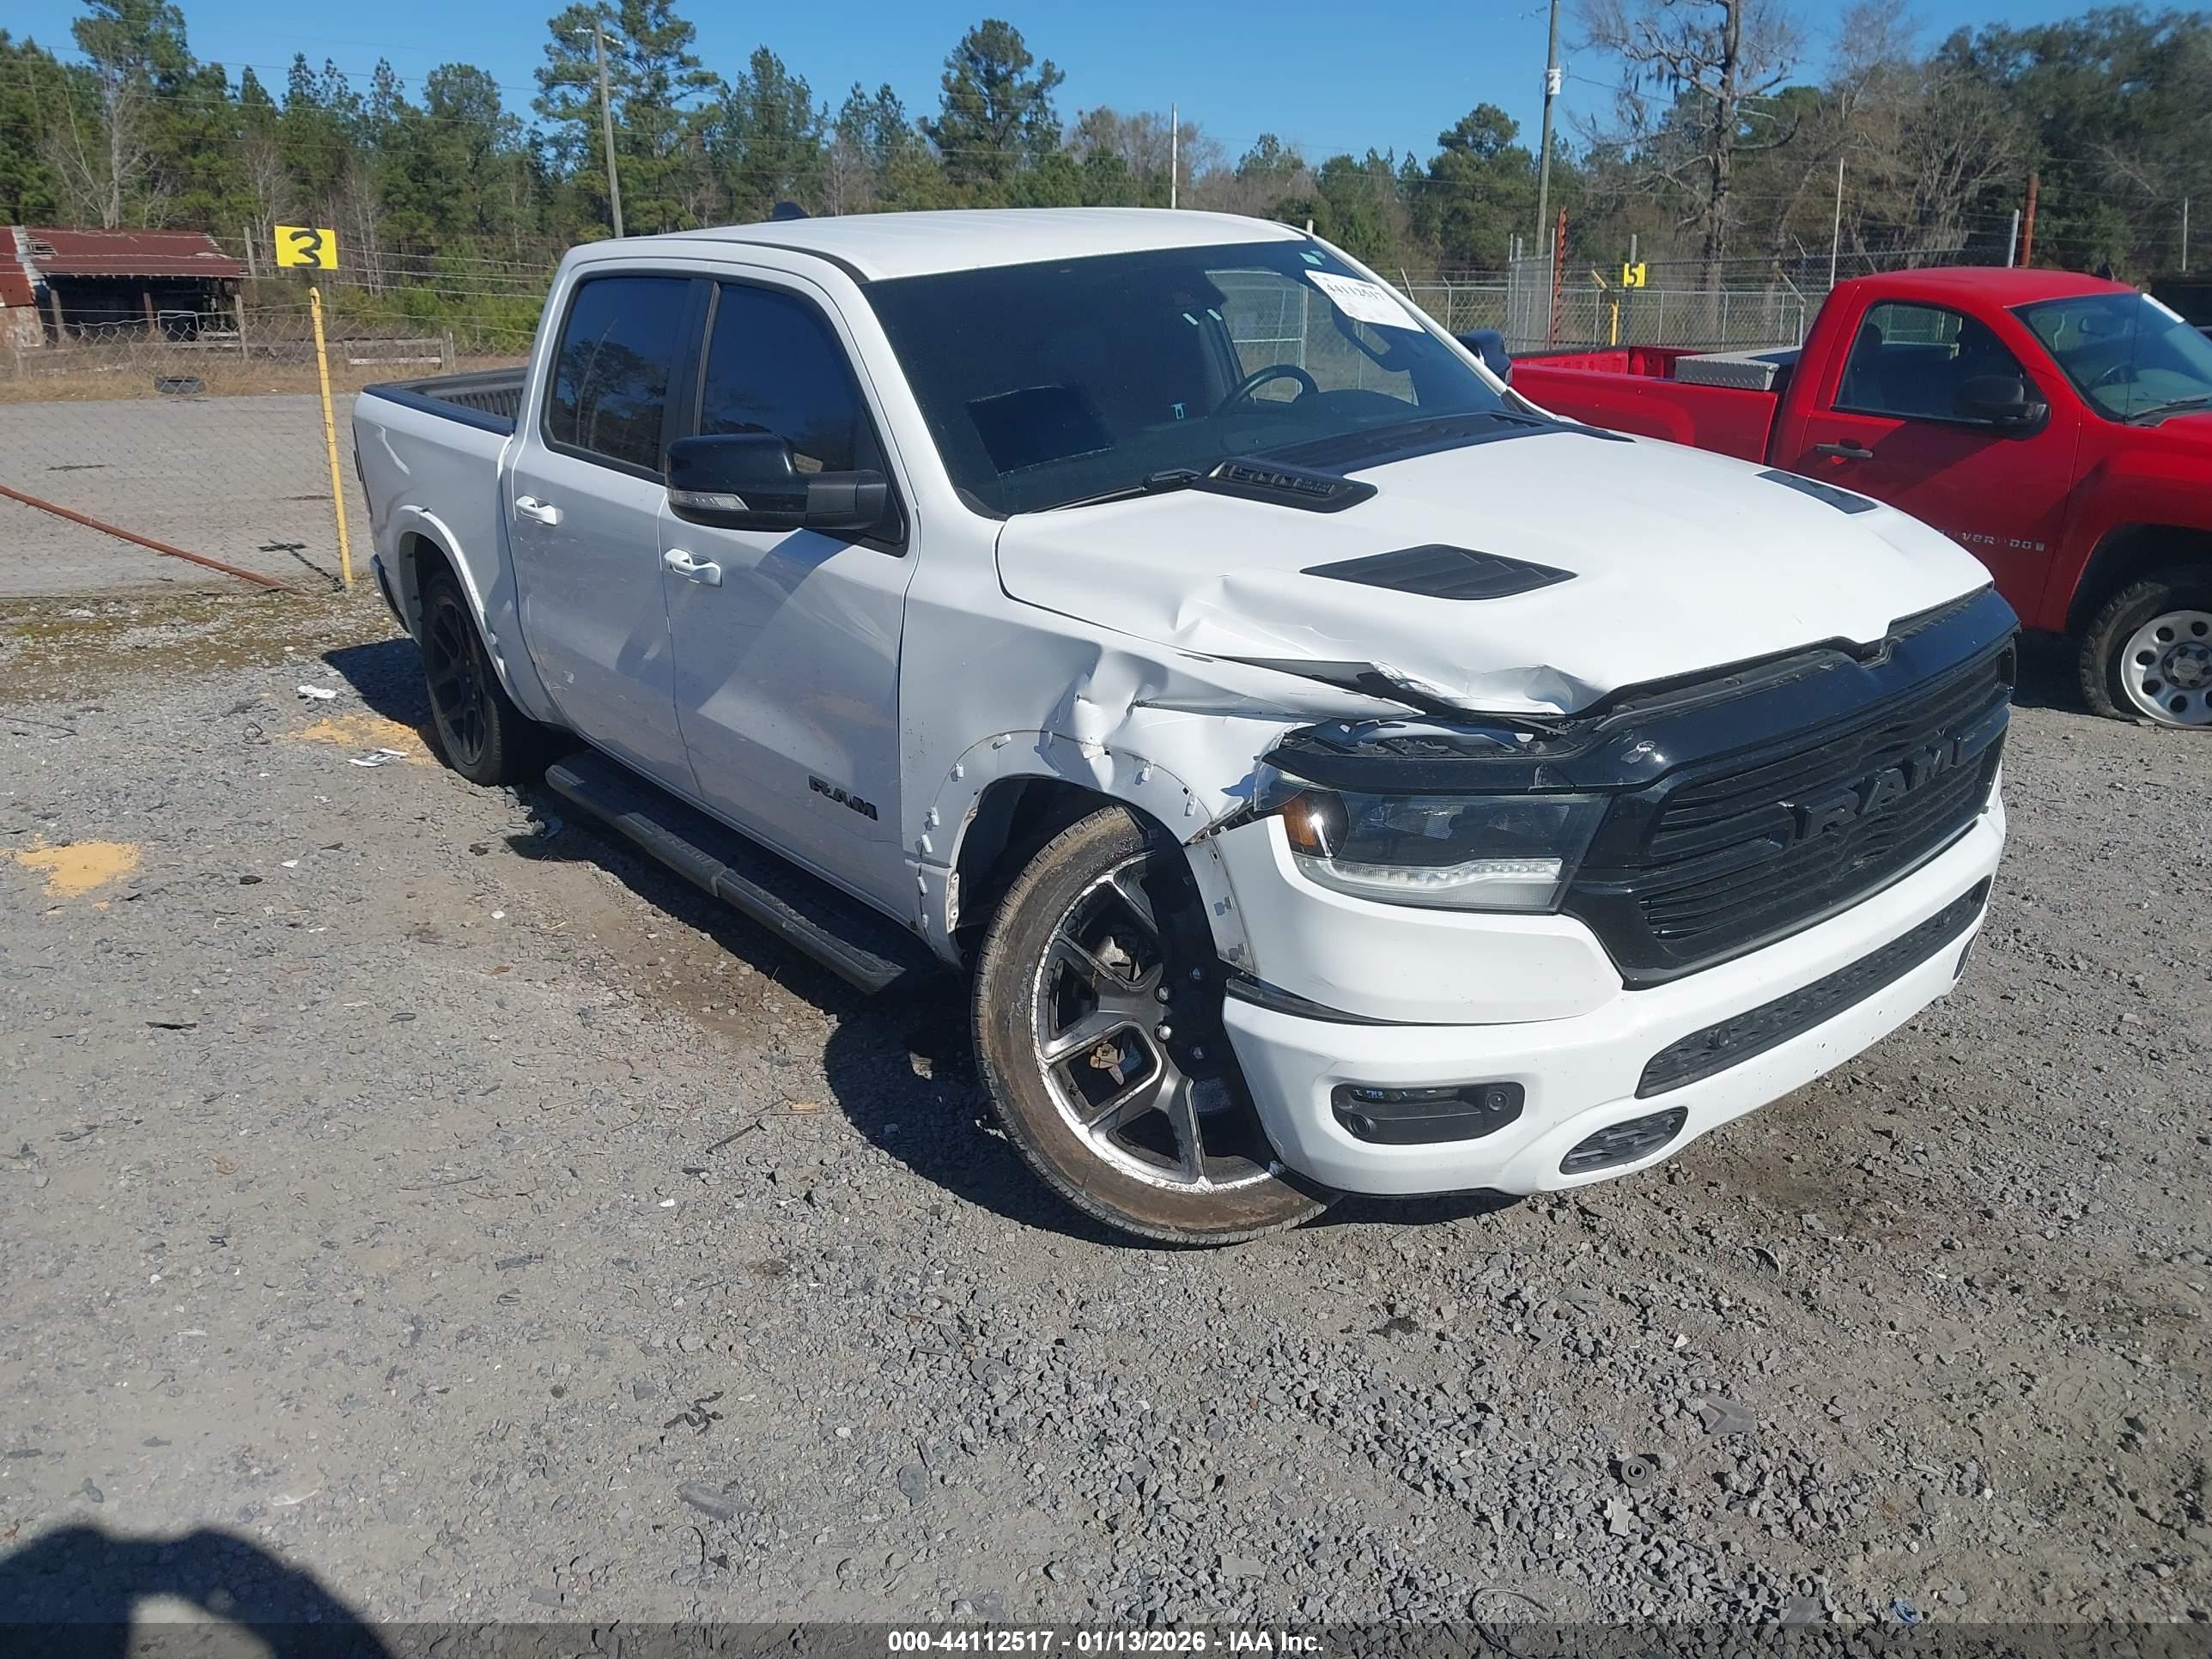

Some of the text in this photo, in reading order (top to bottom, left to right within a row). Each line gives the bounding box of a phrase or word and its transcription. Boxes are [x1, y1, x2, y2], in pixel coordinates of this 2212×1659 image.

[289, 227, 323, 268] 3
[1626, 262, 1640, 288] 5
[808, 774, 878, 822] RAM
[1804, 732, 1955, 839] RAM
